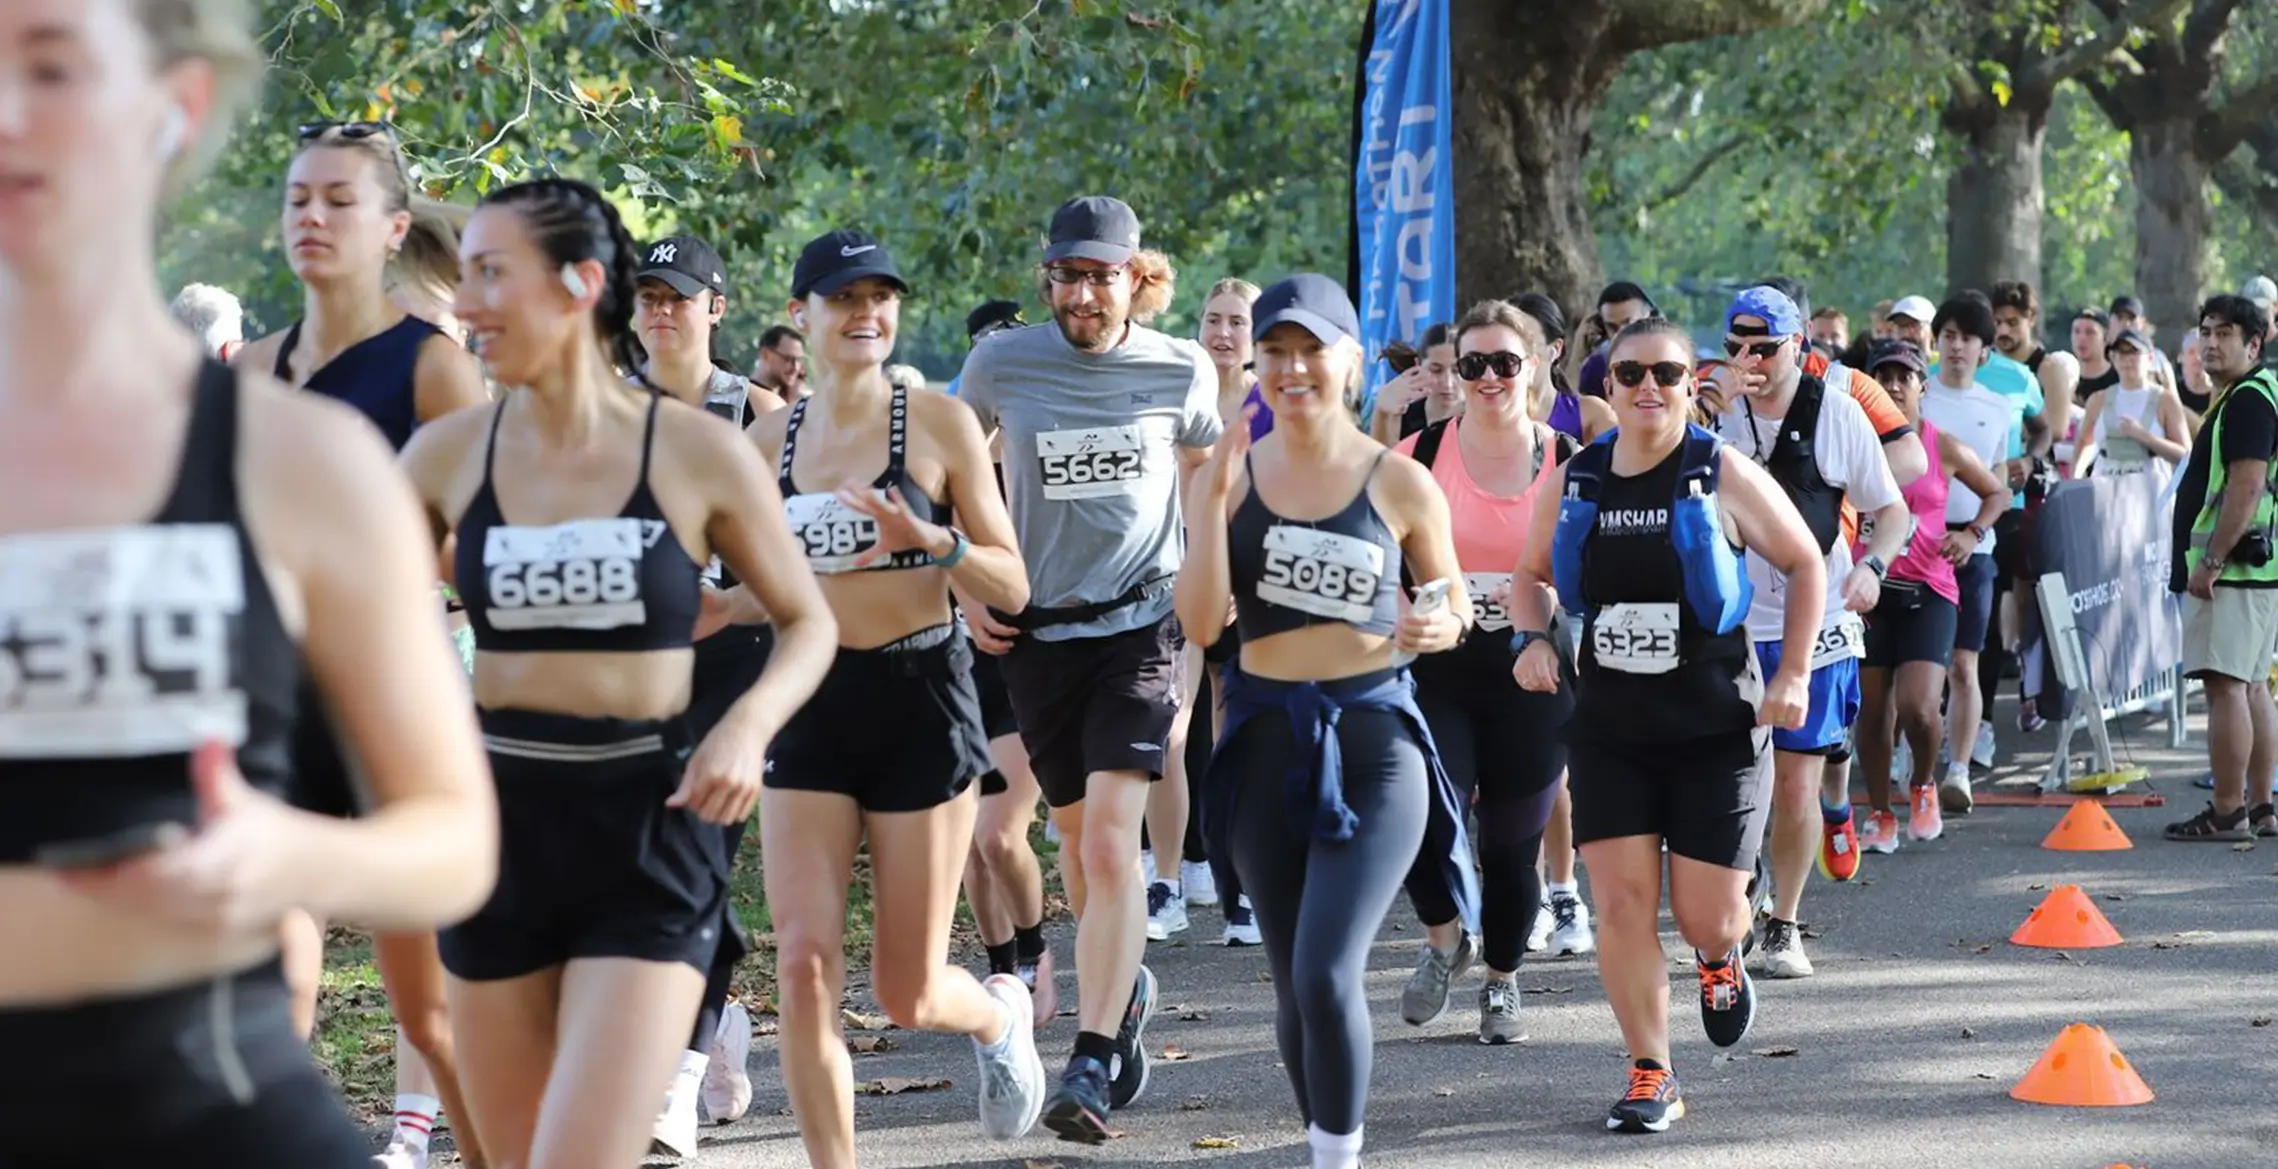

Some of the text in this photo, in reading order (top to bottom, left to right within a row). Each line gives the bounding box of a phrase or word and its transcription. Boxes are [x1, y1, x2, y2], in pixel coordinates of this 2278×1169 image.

[891, 388, 905, 454] ARMOUR
[1043, 450, 1140, 485] 5662
[489, 557, 638, 609] 6688
[1262, 550, 1377, 604] 5089
[1592, 626, 1677, 658] 6323
